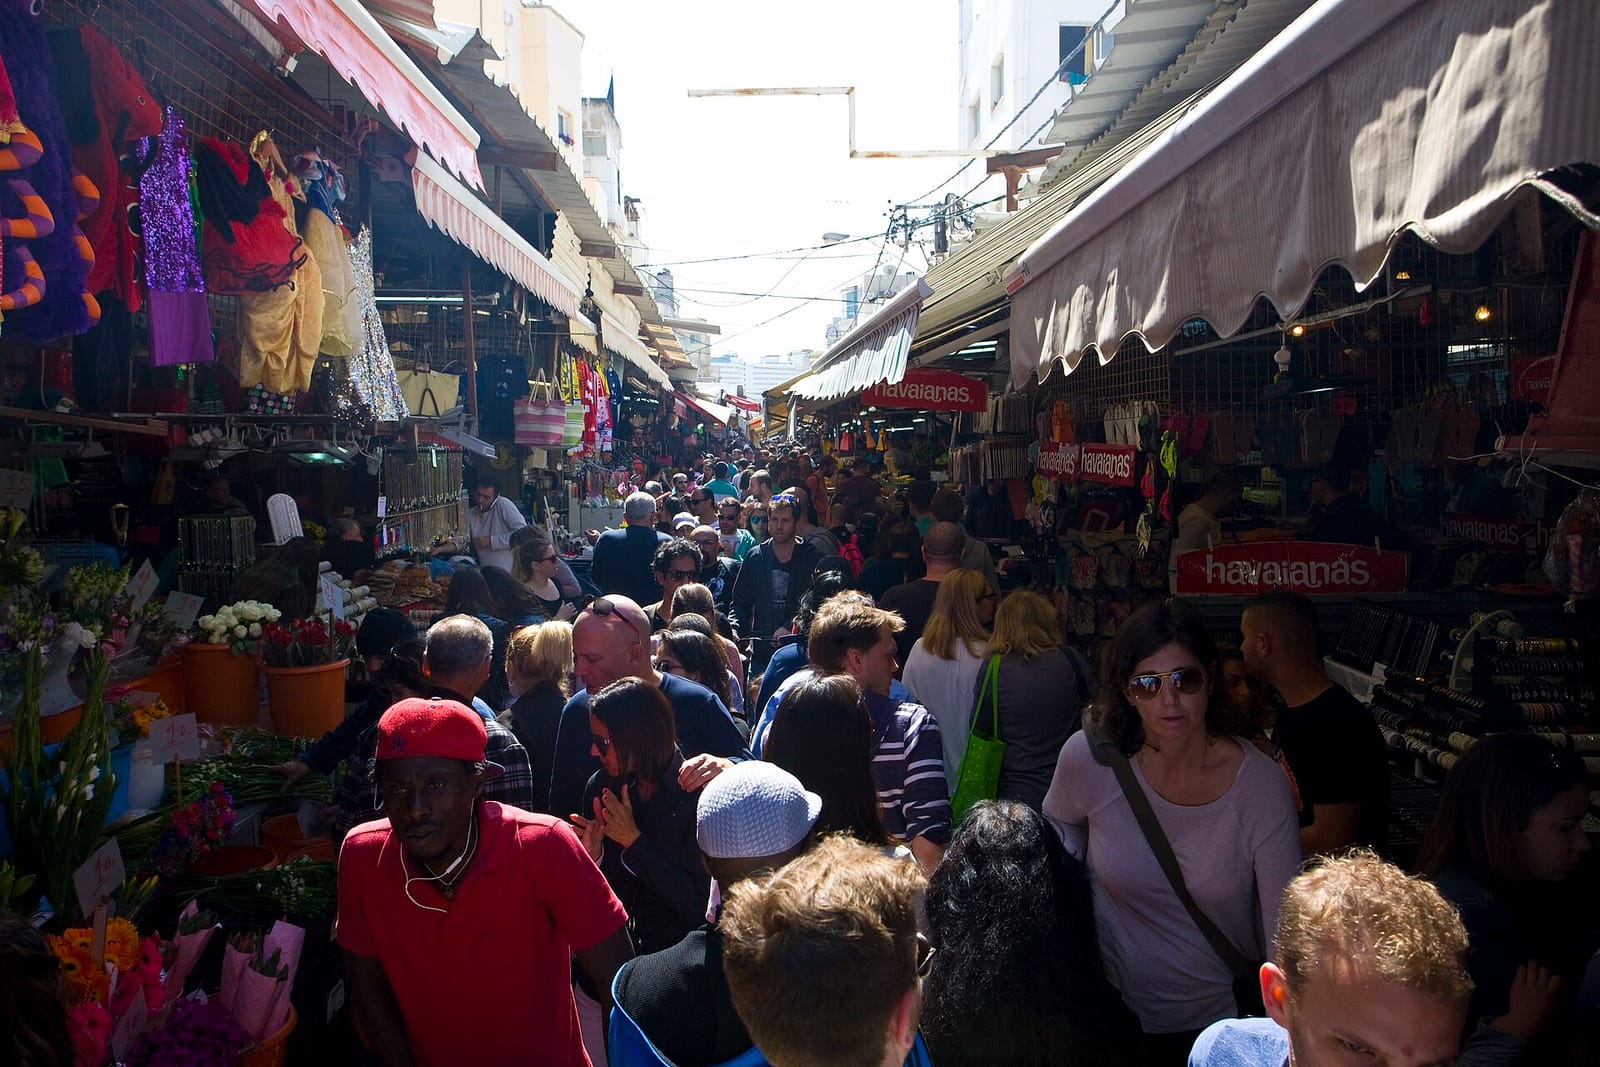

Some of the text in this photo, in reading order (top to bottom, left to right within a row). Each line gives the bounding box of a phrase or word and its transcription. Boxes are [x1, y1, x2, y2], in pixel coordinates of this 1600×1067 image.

[874, 382, 970, 403] havaianas
[1037, 446, 1076, 474] havaianas
[1081, 446, 1130, 479] havaianas
[1440, 514, 1520, 545] havaianas
[1206, 553, 1370, 589] havaianas
